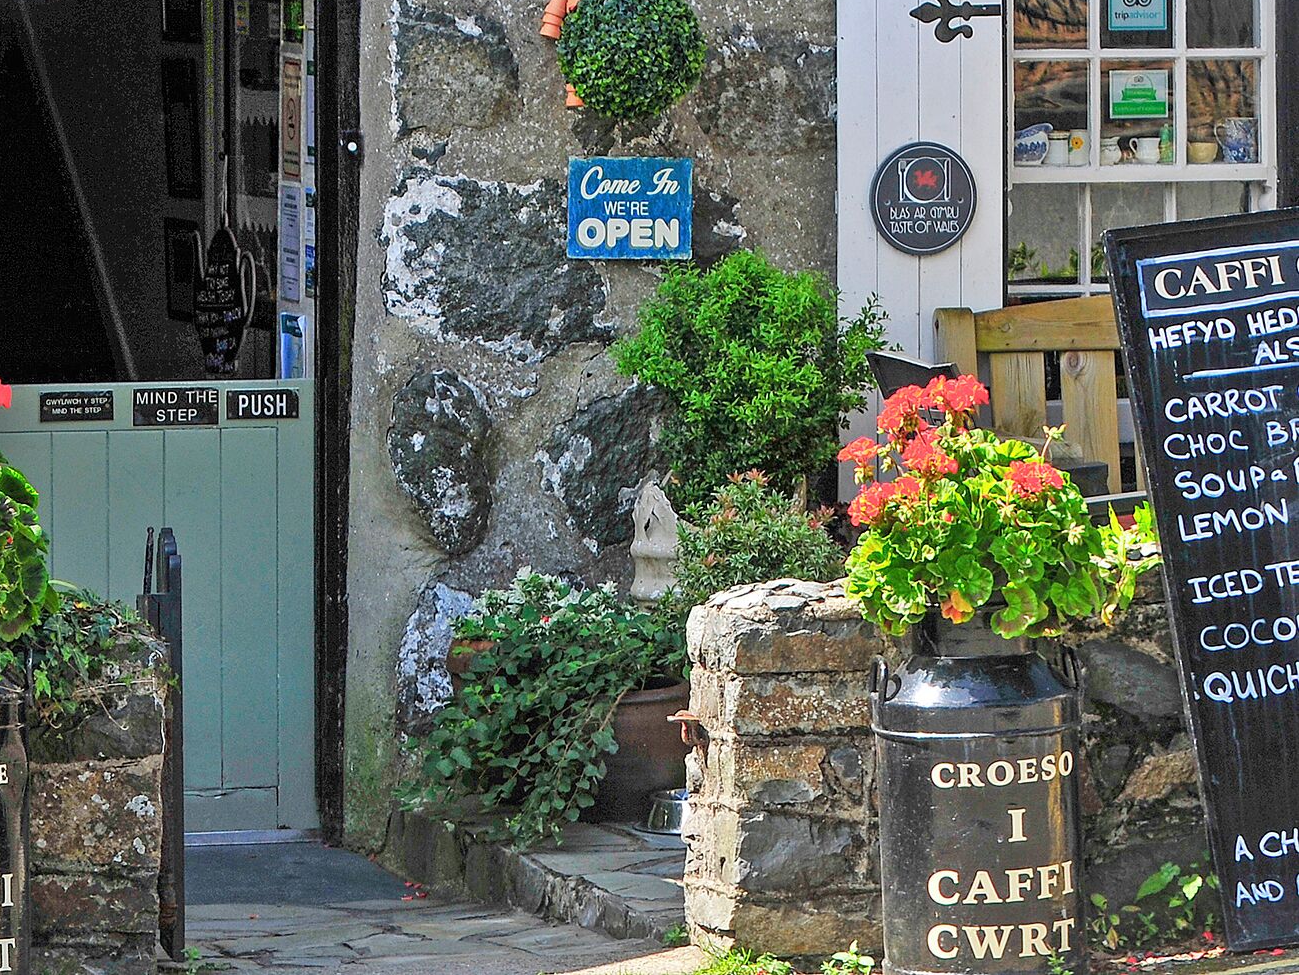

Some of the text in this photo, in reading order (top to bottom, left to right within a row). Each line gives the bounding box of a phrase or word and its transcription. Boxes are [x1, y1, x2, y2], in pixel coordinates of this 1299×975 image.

[1114, 10, 1158, 21] tripadvisor
[580, 165, 681, 200] Come In
[603, 201, 649, 216] WE'RE
[914, 206, 926, 219] AR
[576, 217, 680, 249] OPEN
[889, 221, 960, 234] TASTE OF WALES
[1154, 255, 1286, 300] CAFFI
[1148, 306, 1299, 351] HEFYD HED
[84, 406, 102, 414] STEP
[90, 397, 108, 405] STEP
[136, 390, 217, 405] MIND THE
[238, 394, 287, 416] PUSH
[1164, 385, 1283, 423] CARROT
[156, 408, 198, 422] STEP
[1163, 429, 1249, 460] CHOC
[1177, 497, 1289, 542] LEMON
[1187, 569, 1263, 604] ICED
[1200, 616, 1299, 651] COCO
[930, 750, 1074, 789] CROESO
[1007, 808, 1028, 843] I
[1235, 834, 1254, 862] A
[927, 860, 1075, 906] CAFFI
[1236, 881, 1284, 908] AND
[927, 917, 1075, 960] CWRT
